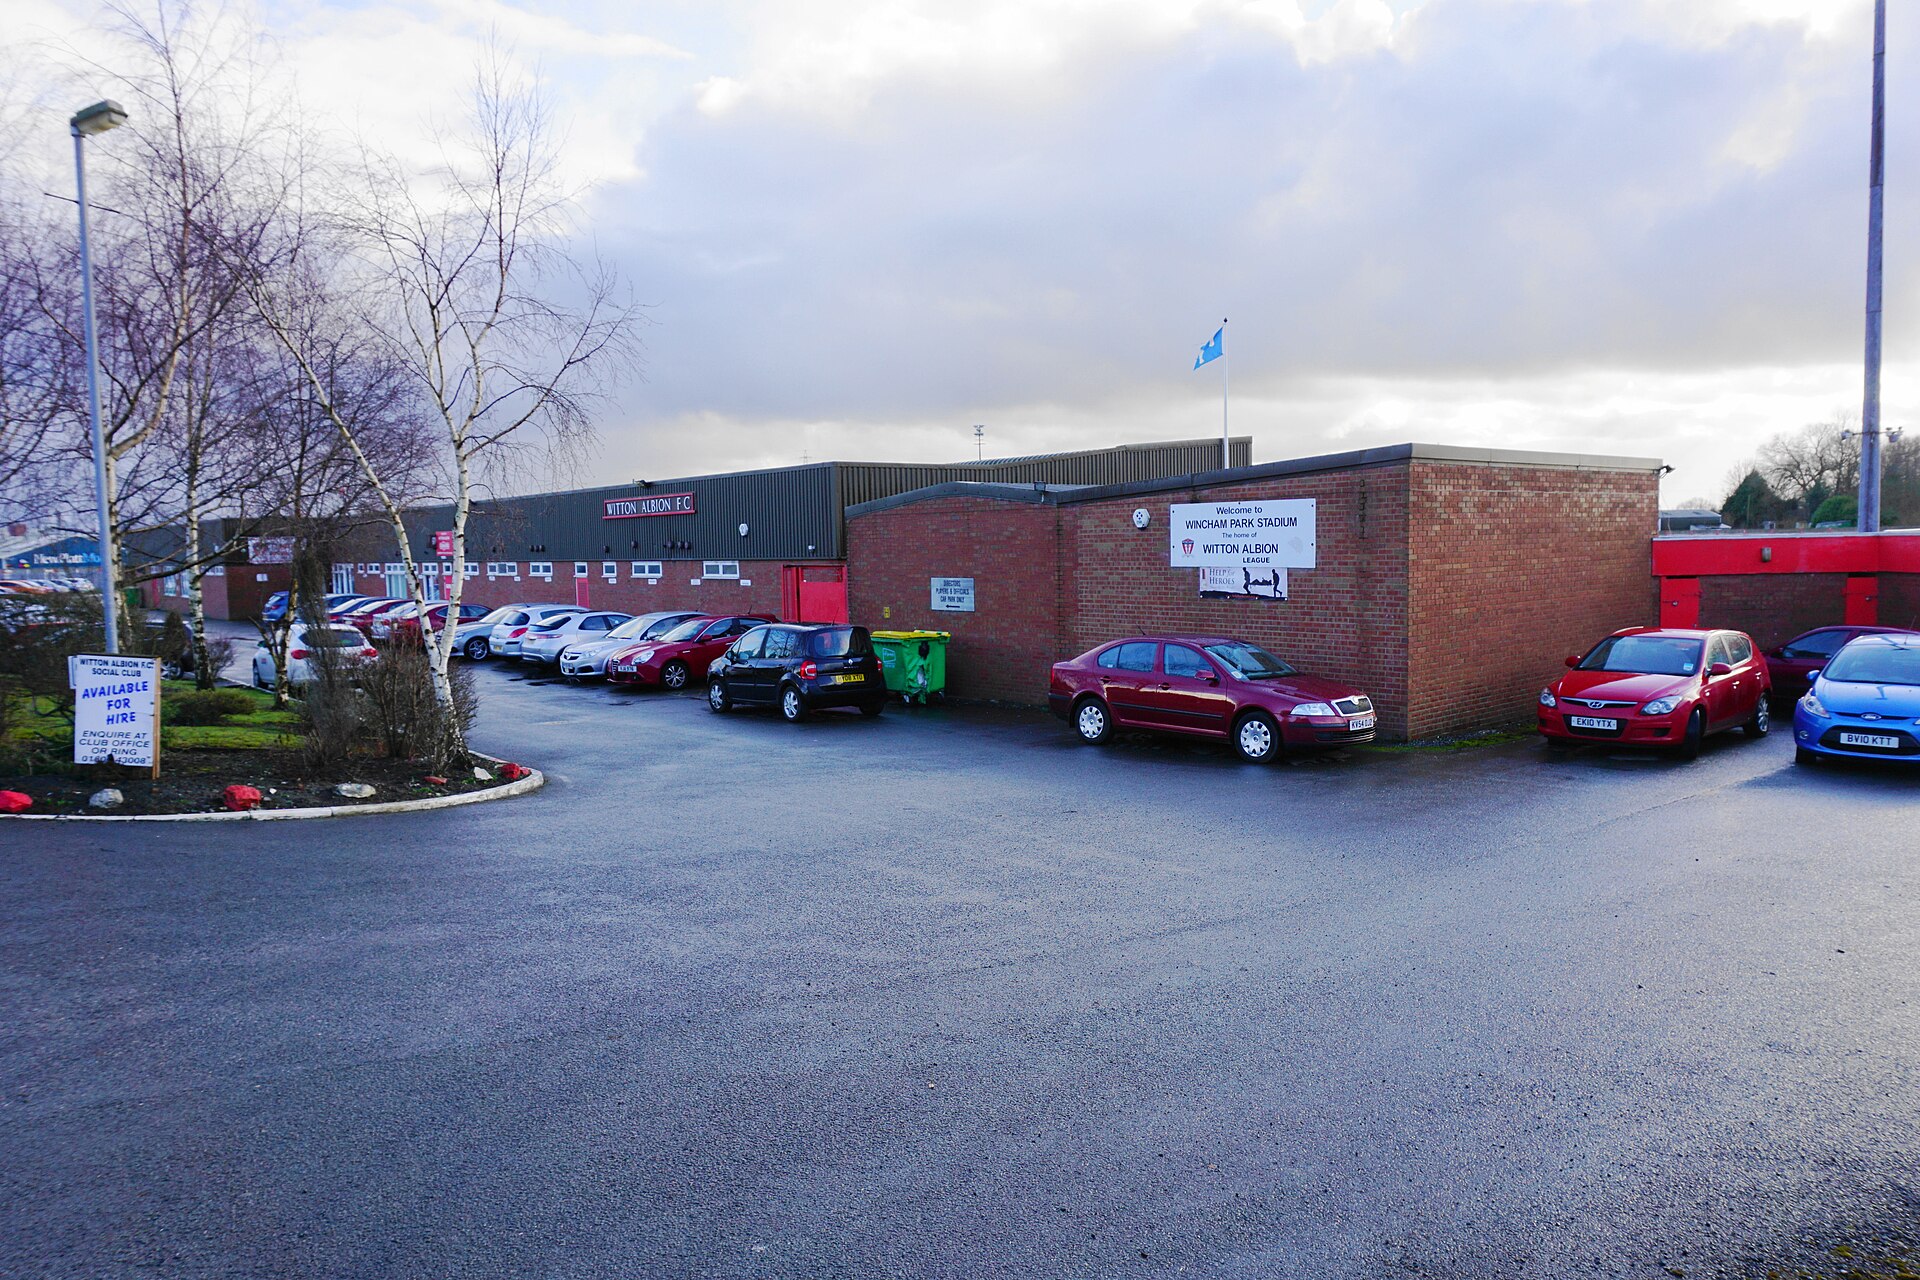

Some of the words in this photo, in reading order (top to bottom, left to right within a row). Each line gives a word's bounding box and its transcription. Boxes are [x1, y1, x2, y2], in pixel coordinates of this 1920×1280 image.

[606, 502, 636, 515] WITTON
[641, 498, 671, 513] ALBION
[676, 497, 681, 511] F
[683, 496, 691, 510] C
[1216, 506, 1252, 515] Welcome
[1254, 506, 1263, 514] to
[1185, 519, 1228, 530] WINCHAM
[1230, 518, 1255, 529] PARK
[1257, 517, 1298, 528] STADIUM
[1202, 544, 1239, 554] WITTON
[1242, 543, 1279, 554] ALBION
[80, 659, 109, 667] WITTON
[111, 660, 139, 668] ALBION
[92, 668, 119, 676] SOCIAL
[121, 669, 142, 677] CLUB
[82, 681, 149, 699] AVAILABLE
[107, 698, 131, 710] FOR
[106, 711, 136, 725] HIRE
[1577, 718, 1595, 727] EK10
[1596, 719, 1612, 728] YTX
[82, 730, 131, 739] ENQUIRE
[112, 740, 150, 748] OFFICE
[1847, 735, 1870, 744] BV10
[1872, 736, 1892, 745] KTT
[111, 747, 137, 756] RING
[81, 755, 111, 763] 0160
